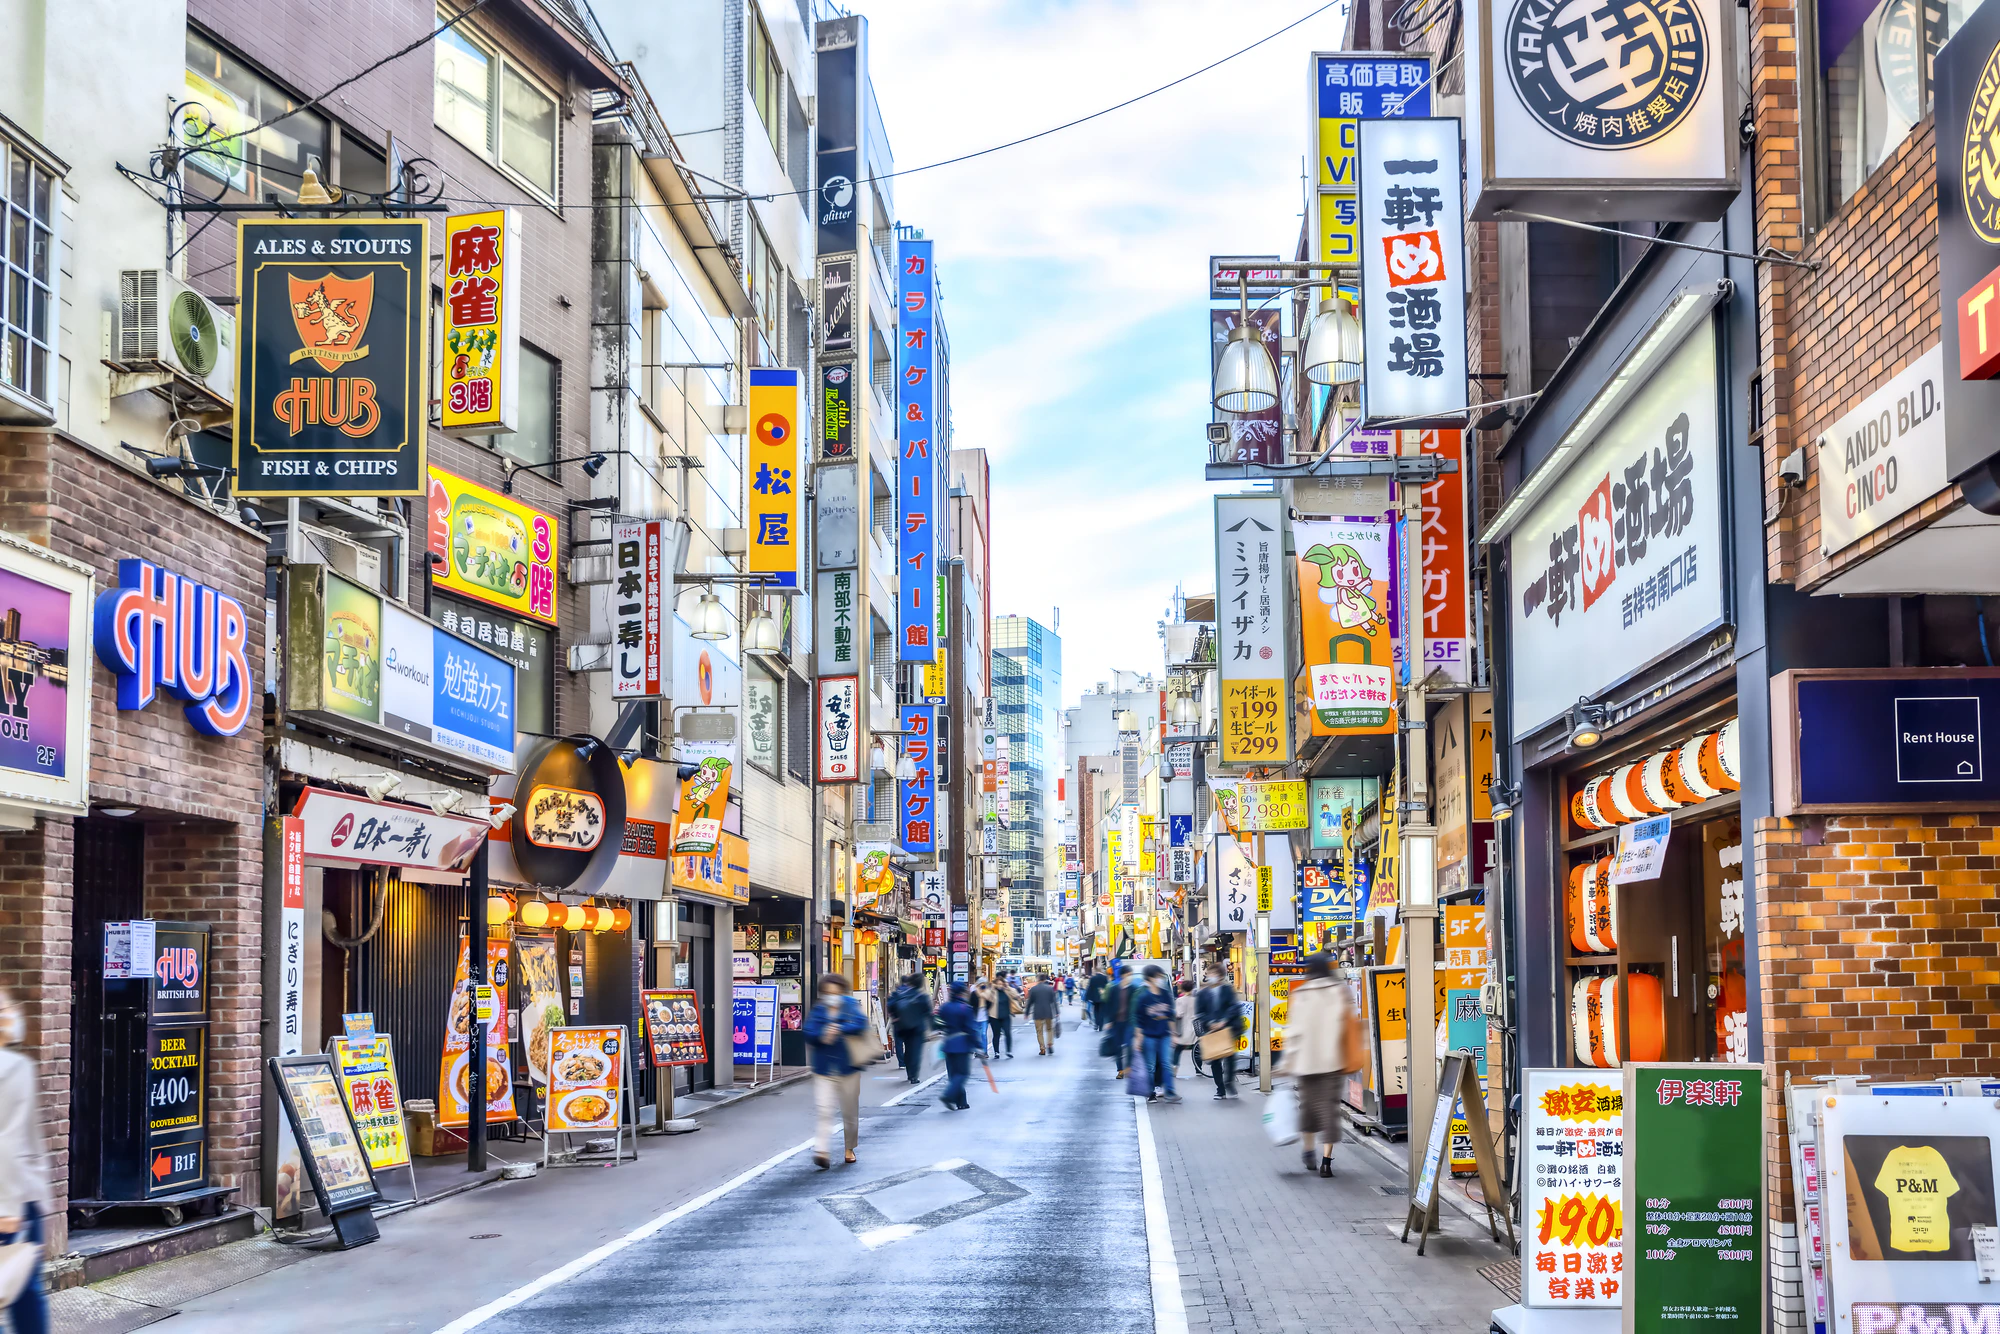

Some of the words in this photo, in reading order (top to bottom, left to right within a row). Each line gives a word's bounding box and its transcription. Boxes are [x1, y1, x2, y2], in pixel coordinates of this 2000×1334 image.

[1325, 63, 1423, 88] 高価買取
[1538, 75, 1689, 138] 一人焼肉推奨店
[821, 209, 853, 225] glitter
[253, 239, 306, 256] ALES
[310, 239, 327, 256] &
[330, 238, 412, 256] STOUTS
[448, 224, 501, 328] 麻雀
[824, 271, 841, 289] club
[1381, 158, 1447, 379] 一軒め酒場
[824, 284, 852, 341] RACING
[300, 349, 337, 362] BRITISH
[338, 349, 359, 362] PUB
[448, 376, 493, 414] 3階
[273, 377, 381, 438] HUB
[825, 387, 839, 441] EARTH
[838, 400, 850, 428] club
[1845, 409, 1892, 475] ANDO
[1896, 378, 1941, 438] BLD.
[831, 443, 846, 453] 3F
[905, 254, 928, 647] カラオケ&パーティー館
[1238, 448, 1259, 461] 2F
[1350, 440, 1390, 455] 管理
[261, 459, 310, 477] FISH
[314, 459, 330, 477] &
[333, 459, 398, 477] CHIPS
[1318, 477, 1364, 490] 吉祥寺
[1846, 455, 1898, 520] CINCO
[752, 462, 792, 546] 松屋
[1523, 411, 1694, 629] 一軒め酒場
[359, 550, 379, 562] TOSHIBA
[529, 514, 554, 619] 3階
[1258, 541, 1272, 635] 旨唐揚げと居酒メシ
[1621, 544, 1698, 631] 吉祥寺南口店
[616, 540, 643, 679] 日本一寿し
[1230, 541, 1255, 662] ミライザカ
[833, 571, 852, 663] 南部不動産
[441, 610, 525, 654] 寿司居酒屋
[105, 560, 252, 737] HUB
[529, 637, 537, 657] 2階
[1433, 641, 1460, 659] 5F
[396, 663, 431, 687] workout
[441, 650, 510, 720] 勉強カフェ
[1229, 685, 1278, 698] ハイボール
[450, 706, 479, 724] KICHIJOJI
[480, 718, 500, 733] STUDIO
[825, 694, 851, 731] 安安
[1230, 701, 1278, 719] ¥199
[0, 721, 29, 742] OJI
[1229, 721, 1278, 736] 生ビール
[1902, 731, 1933, 744] Rent
[1935, 730, 1975, 744] House
[36, 745, 56, 766] 2F
[1230, 736, 1279, 755] ¥299
[906, 713, 931, 844] カラオケ館
[1240, 782, 1305, 794] 全身もみほぐし
[1316, 784, 1345, 800] 麻雀
[353, 816, 433, 860] 日本一寿し
[532, 824, 596, 847] チャーハン
[638, 839, 657, 855] RICE
[1173, 850, 1185, 882] 筑前屋
[1260, 867, 1270, 910] 防犯カメラ作動中
[1305, 870, 1325, 887] 3F
[1228, 867, 1247, 923] さわ田
[1310, 888, 1365, 906] DVD
[1450, 919, 1470, 936] 5F
[156, 947, 200, 988] HUB
[1449, 949, 1471, 966] 売買
[286, 920, 300, 1036] にぎり寿司
[157, 989, 186, 1000] BRITISH
[186, 989, 200, 999] PUB
[1454, 993, 1482, 1022] 麻
[160, 1038, 187, 1052] BEER
[350, 1077, 397, 1116] 麻雀
[1545, 1087, 1623, 1117] 激安酒場
[1655, 1078, 1742, 1107] 伊楽軒
[156, 1117, 175, 1128] COVER
[175, 1114, 198, 1126] CHARGE
[174, 1153, 197, 1173] B1F
[1597, 1164, 1617, 1175] 白鶴
[1895, 1178, 1939, 1194] P&M
[1645, 1197, 1671, 1210] 60分
[1717, 1198, 1753, 1211] 4500円
[1645, 1223, 1671, 1236] 70分
[1717, 1224, 1753, 1236] 4800円
[1666, 1238, 1733, 1248] 全身アロマリンパ
[1645, 1249, 1677, 1261] 100分
[1717, 1249, 1753, 1262] 7800円
[1548, 1277, 1619, 1300] 営業中
